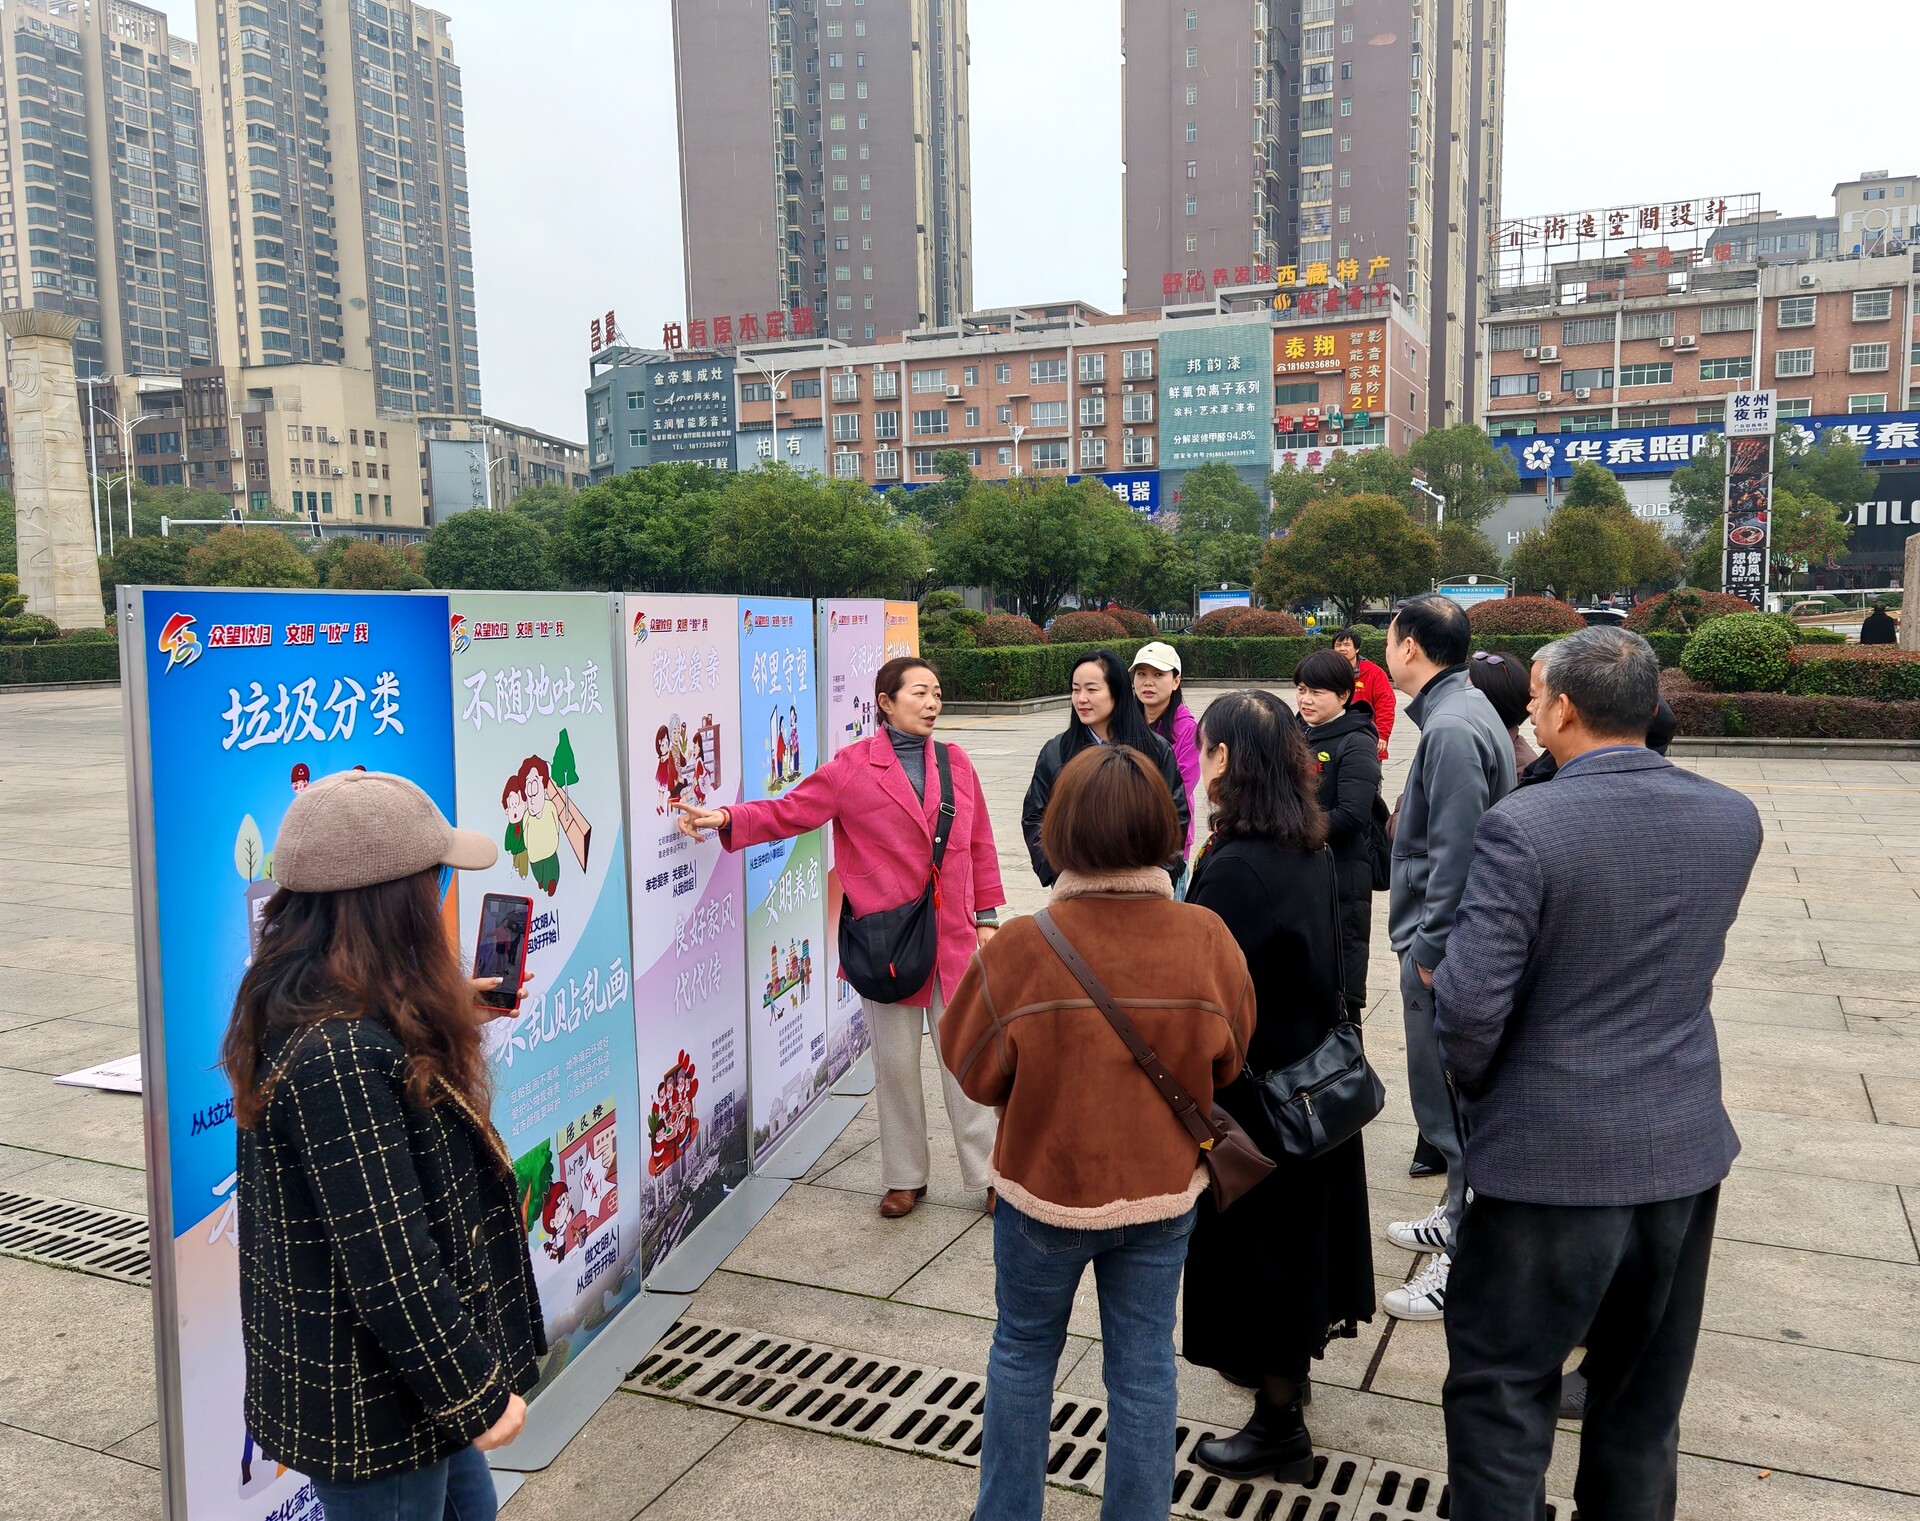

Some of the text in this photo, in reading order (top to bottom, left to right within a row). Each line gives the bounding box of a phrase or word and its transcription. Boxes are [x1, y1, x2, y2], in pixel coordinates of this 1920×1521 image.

[1843, 205, 1920, 233] FOTI
[1275, 256, 1391, 288] 西藏特产
[1284, 334, 1336, 360] 泰翔
[1187, 356, 1241, 374] 邦韵漆
[1286, 359, 1341, 371] 18169336890
[1348, 331, 1364, 396] 智能家居
[1367, 328, 1383, 394] 影音安防
[653, 366, 723, 386] 金帝集成灶
[1351, 395, 1378, 410] 2F
[1733, 407, 1769, 421] 夜市
[1734, 393, 1769, 408] 攸州
[653, 416, 719, 430] 玉润智能影音
[756, 435, 802, 458] 柏有
[1103, 481, 1151, 502] 电器
[1731, 564, 1761, 576] 的风
[1732, 552, 1762, 564] 想你
[206, 622, 273, 648] 众望攸归
[472, 621, 509, 640] 众望攸归
[652, 647, 721, 698] 敬老爱亲
[751, 646, 809, 697] 邻里守望
[462, 658, 604, 731] 不随地吐痰
[221, 670, 405, 752] 垃圾分类
[672, 860, 694, 882] 关爱老人
[765, 856, 819, 928] 文明养宠
[675, 892, 736, 960] 良好家风
[674, 951, 722, 1015] 代代传
[495, 956, 629, 1068] 不乱贴乱画
[566, 1103, 604, 1143] 居民楼
[585, 1227, 617, 1267] 做文明人
[576, 1247, 617, 1296] 从细节开始
